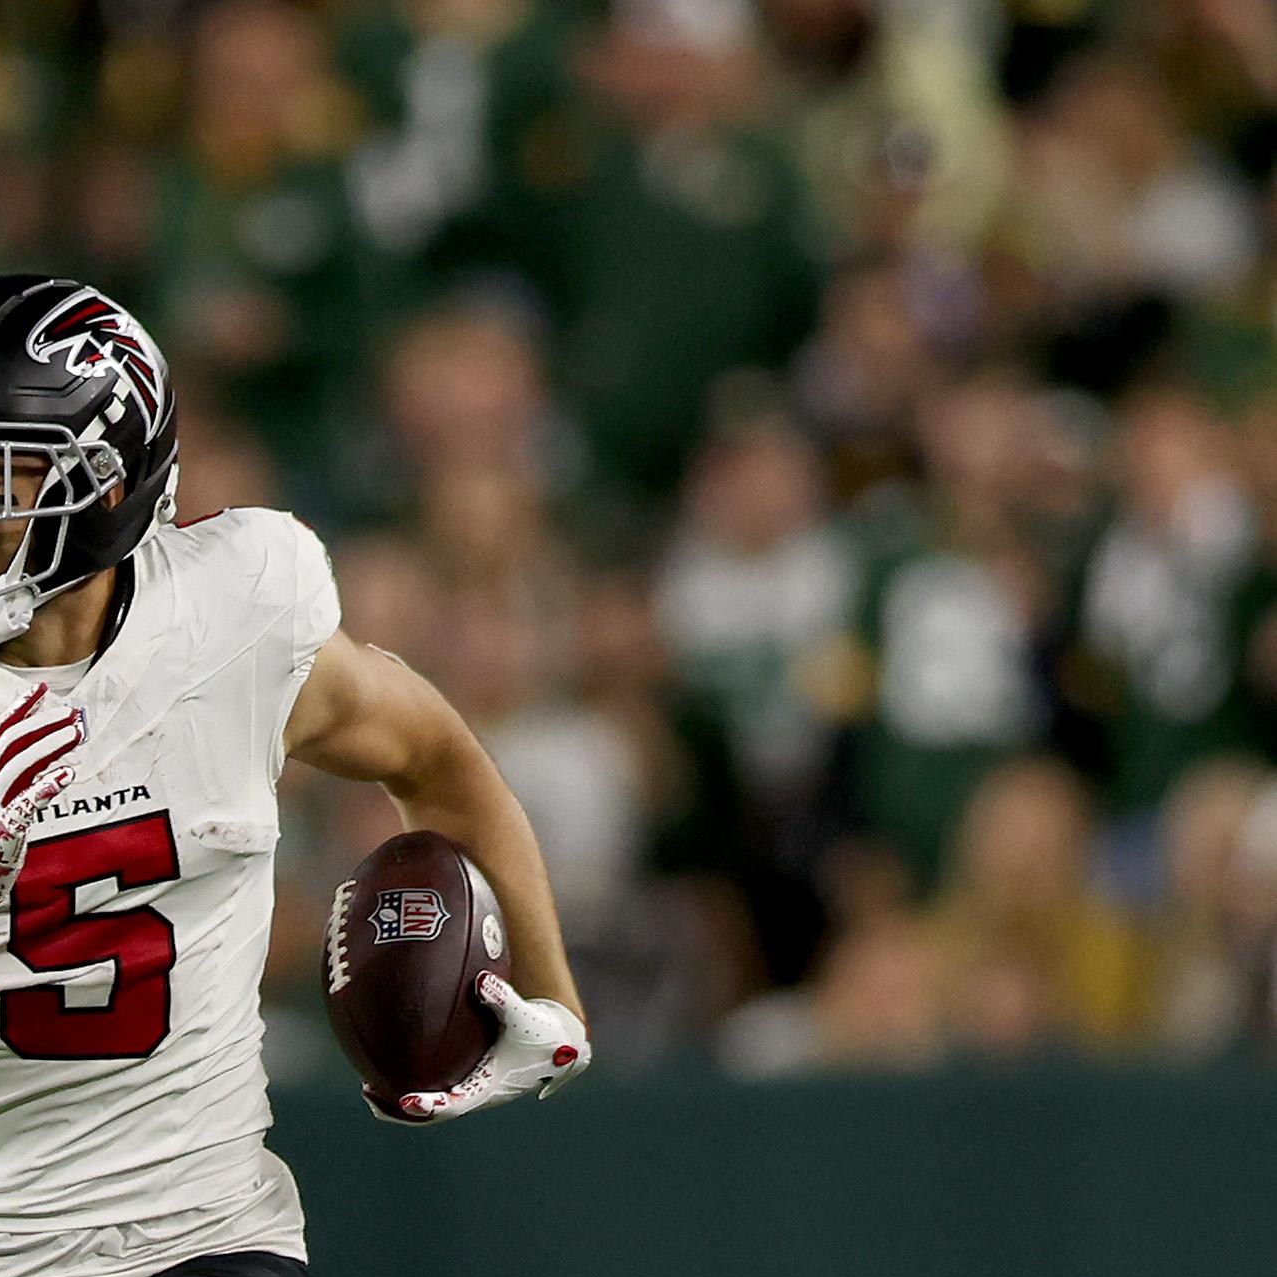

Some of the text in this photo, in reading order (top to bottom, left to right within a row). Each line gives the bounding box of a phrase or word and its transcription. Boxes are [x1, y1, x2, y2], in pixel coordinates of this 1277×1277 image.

[36, 785, 151, 823] TLANTA
[402, 894, 438, 934] NFL
[0, 808, 181, 1061] 5
